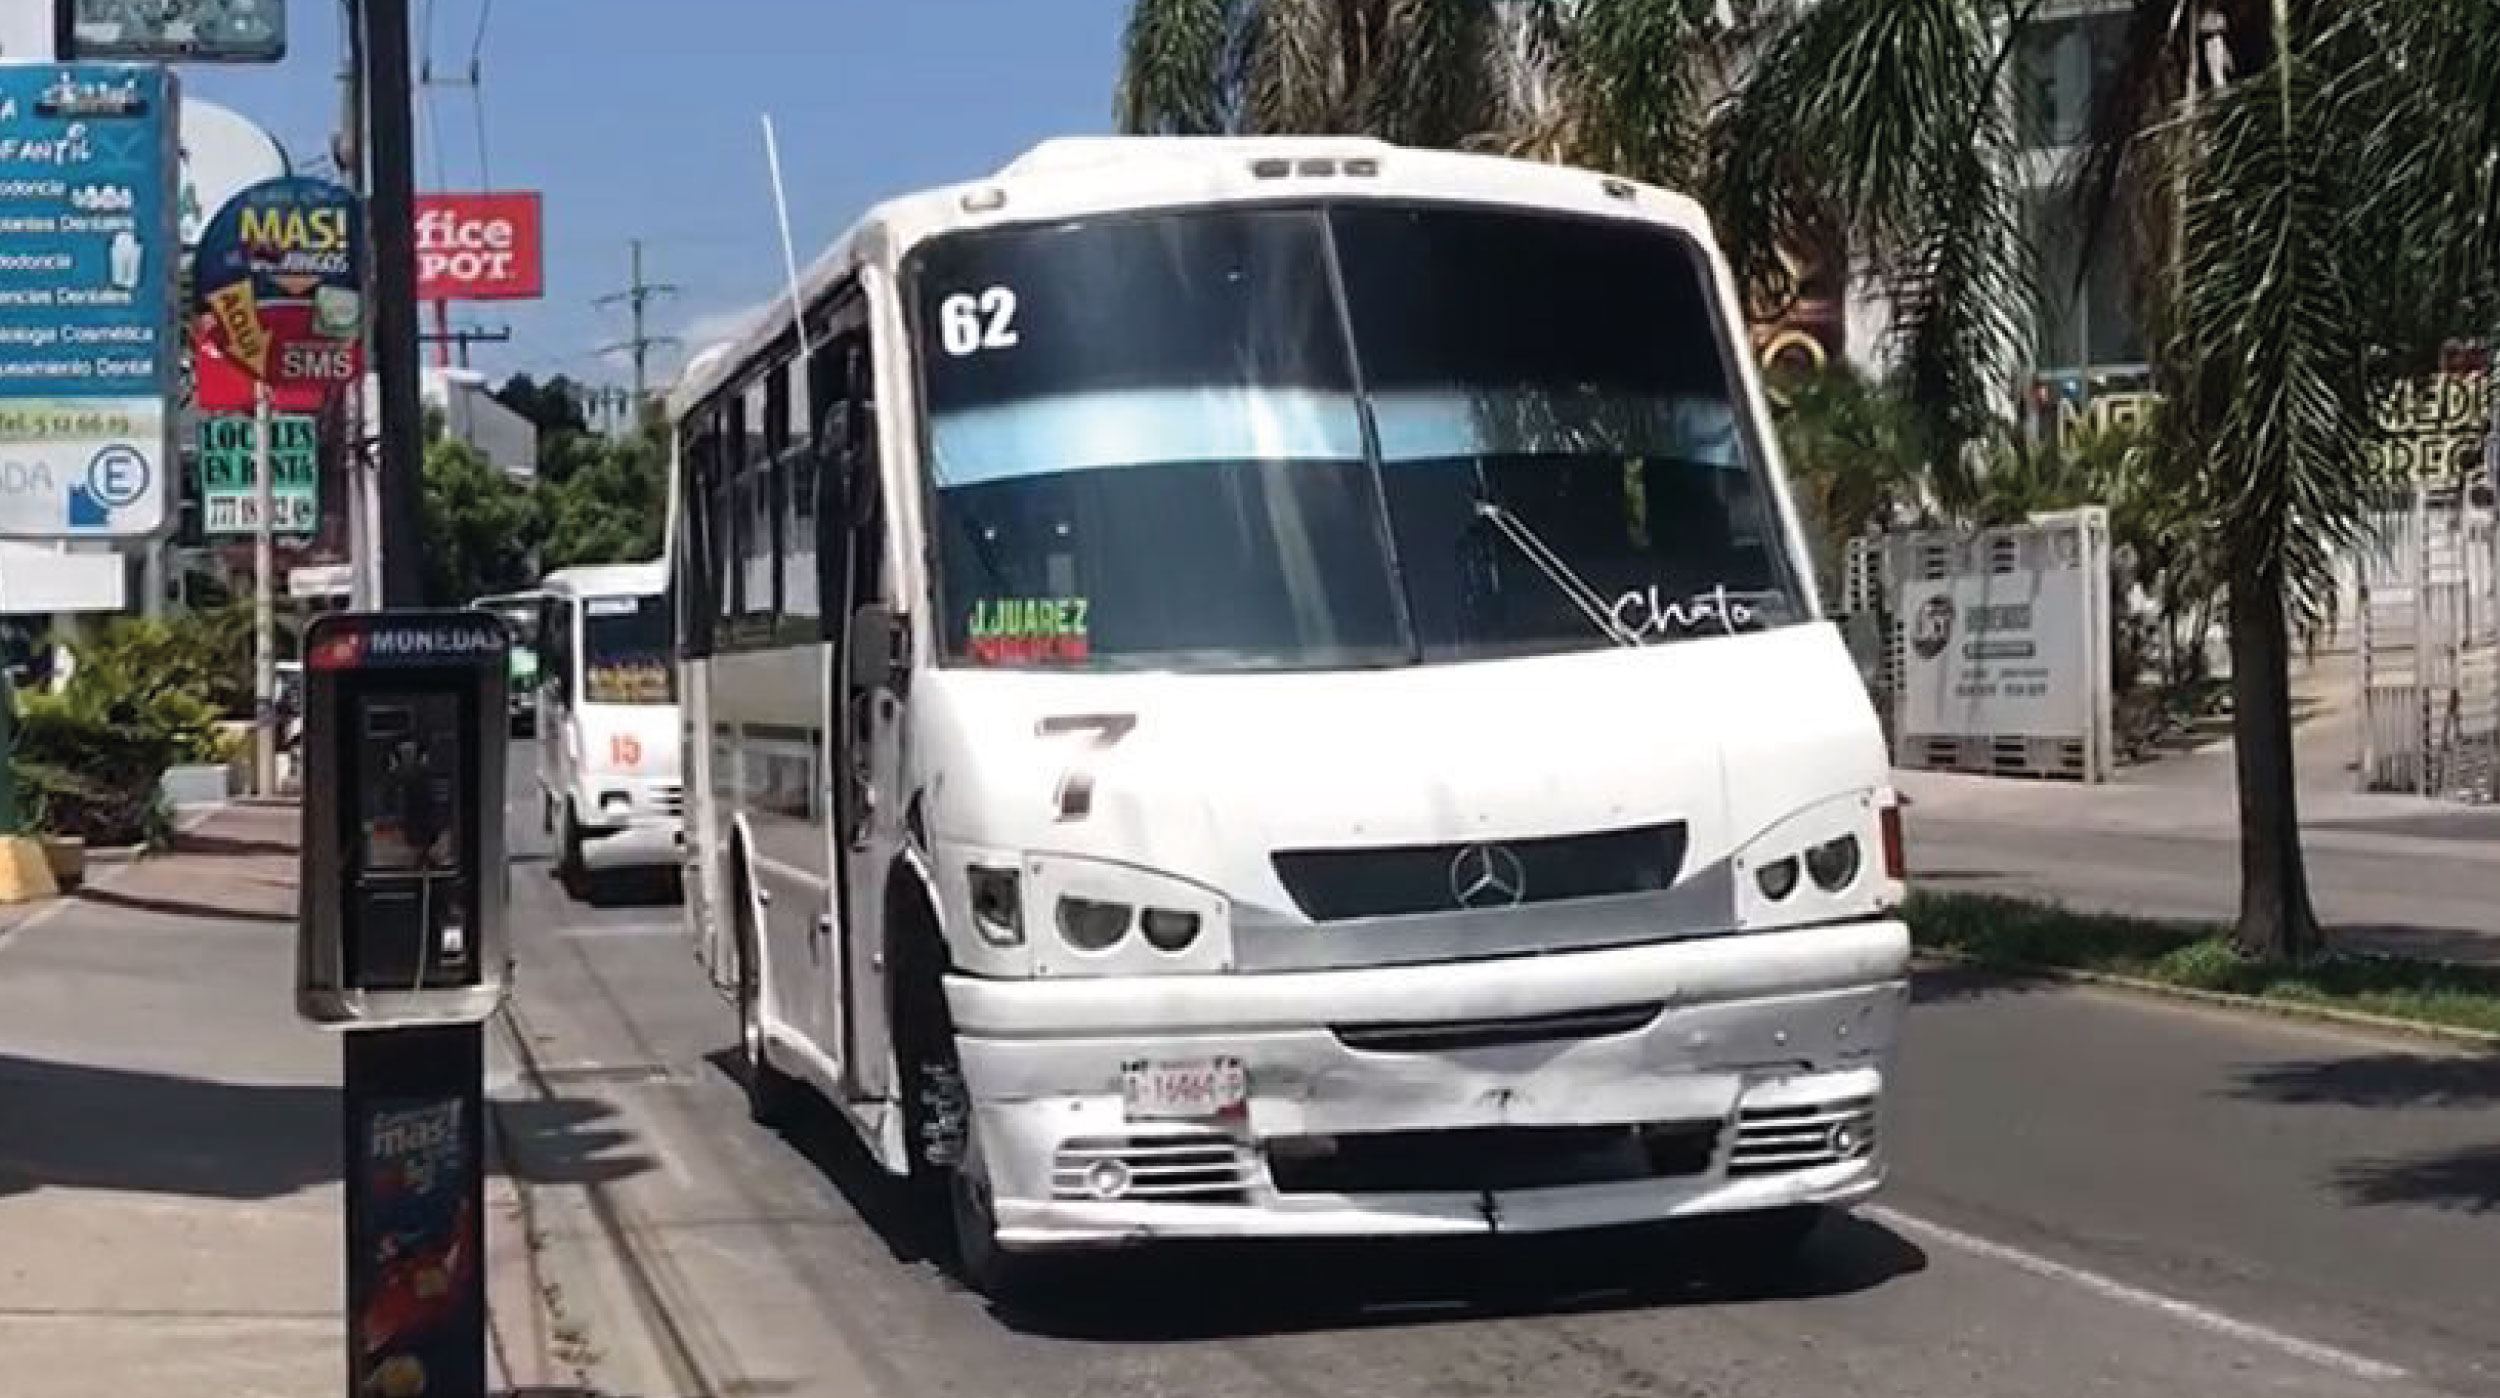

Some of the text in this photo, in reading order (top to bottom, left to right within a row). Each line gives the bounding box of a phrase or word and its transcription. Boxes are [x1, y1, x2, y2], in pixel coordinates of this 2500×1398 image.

[420, 251, 513, 280] POT
[941, 285, 1019, 356] 62
[281, 349, 353, 380] SMS
[203, 421, 314, 452] LOCLES
[240, 454, 314, 486] RNTA
[371, 628, 505, 655] MONEDAS
[1033, 713, 1138, 825] 7
